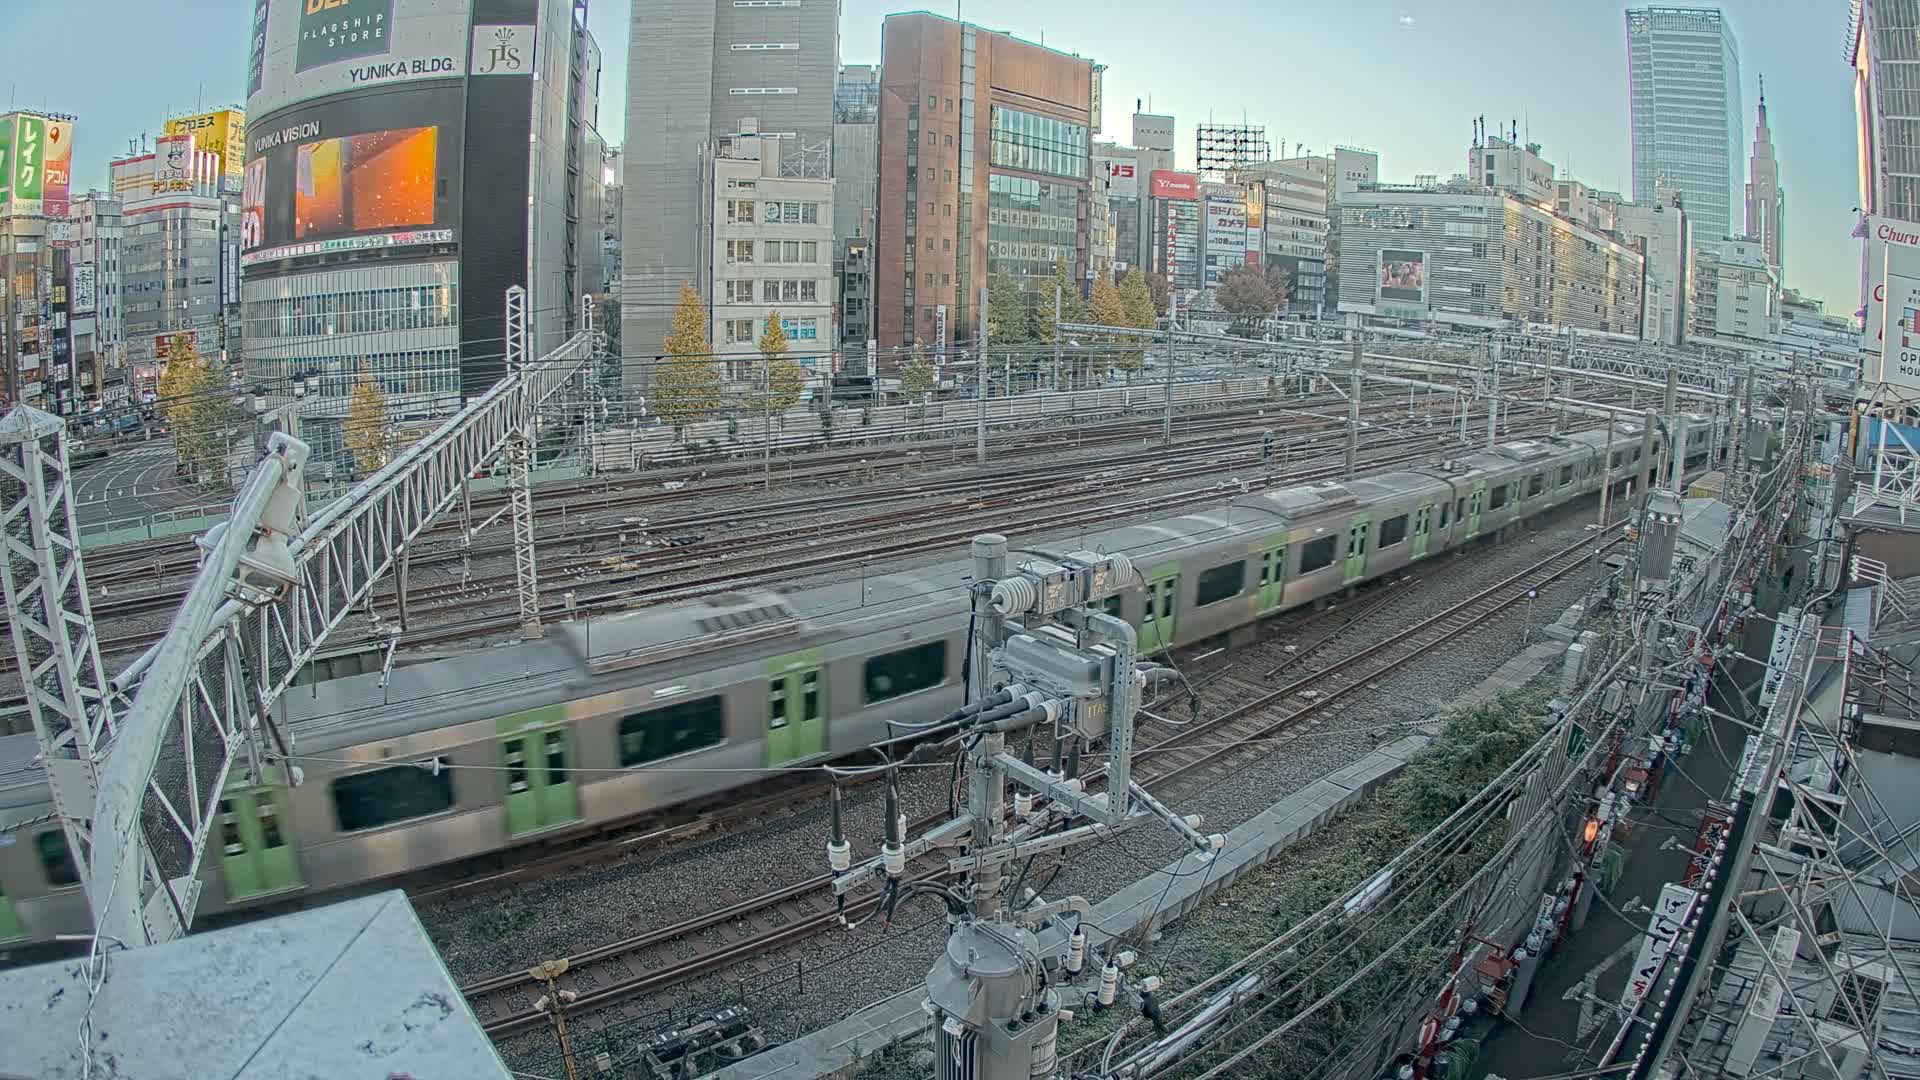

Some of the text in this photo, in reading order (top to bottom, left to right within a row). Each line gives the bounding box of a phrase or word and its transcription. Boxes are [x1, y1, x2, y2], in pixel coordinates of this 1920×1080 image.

[304, 14, 383, 40] FLAGSHIP
[328, 28, 382, 47] STORE
[349, 57, 456, 83] YUNIKA BLDG.
[255, 132, 281, 152] YUNIKA
[282, 121, 320, 144] VISION
[21, 121, 37, 188] レイク
[46, 168, 68, 185] アコム
[1877, 224, 1919, 246] Churu
